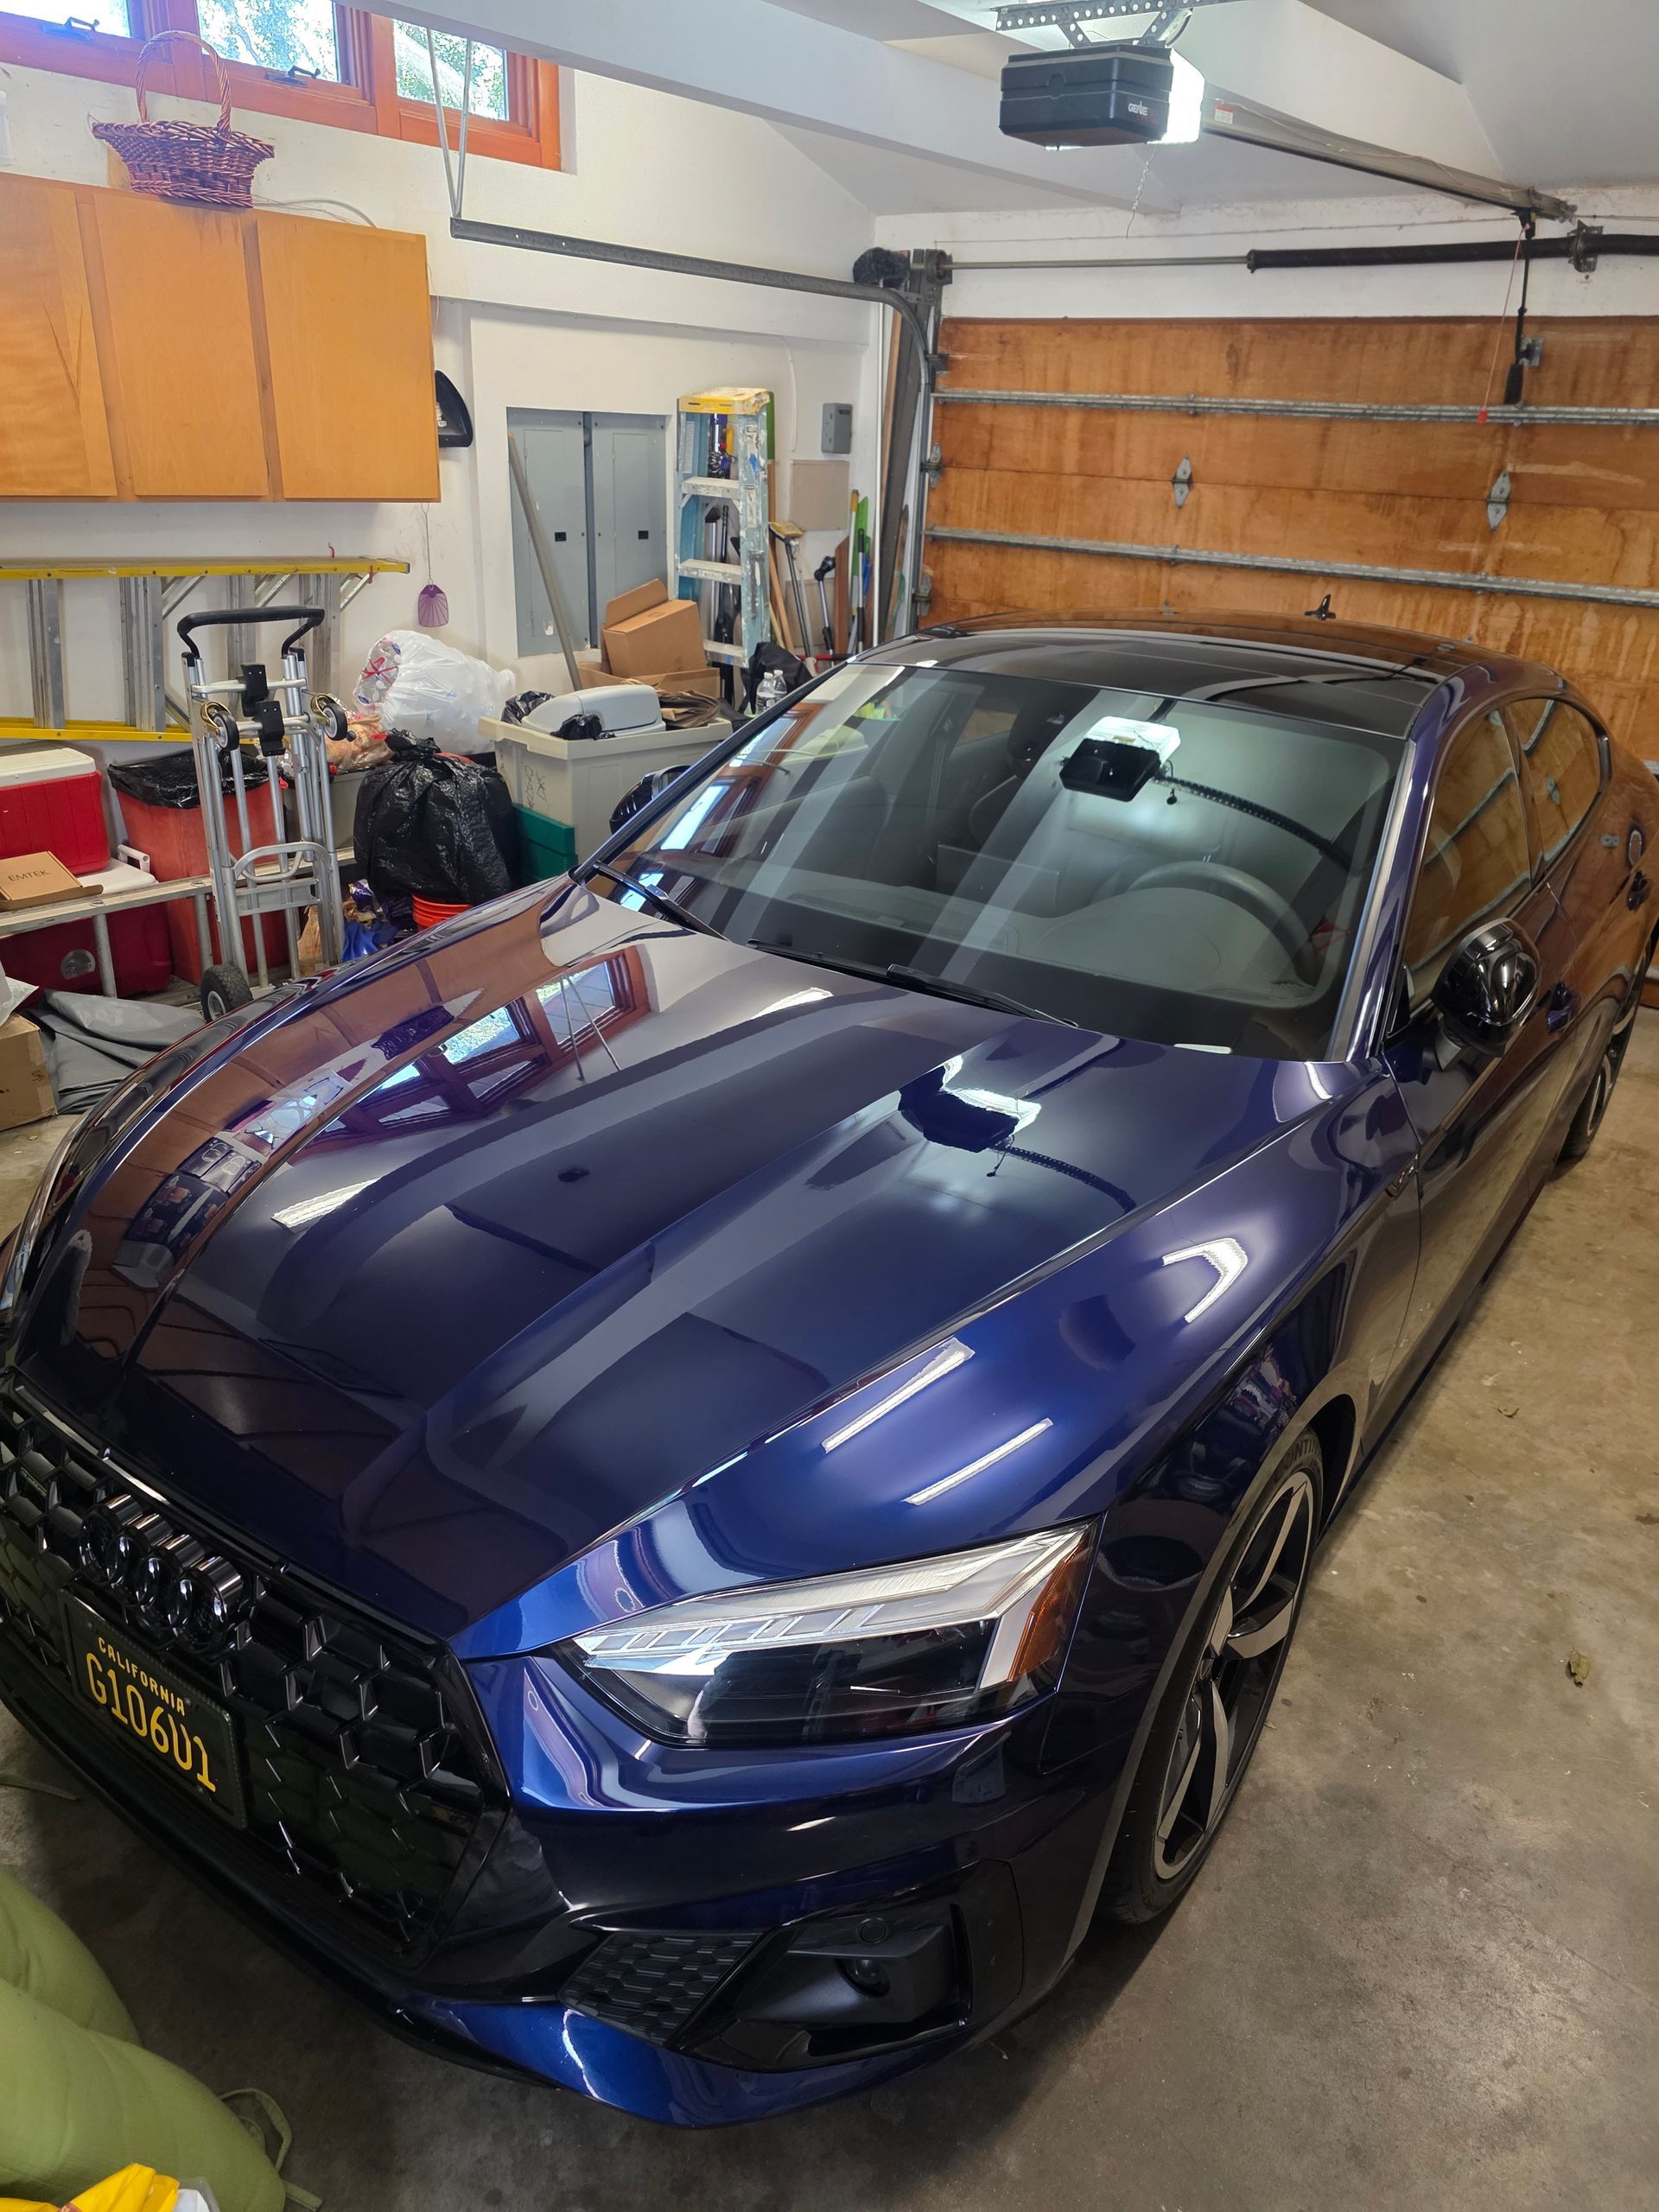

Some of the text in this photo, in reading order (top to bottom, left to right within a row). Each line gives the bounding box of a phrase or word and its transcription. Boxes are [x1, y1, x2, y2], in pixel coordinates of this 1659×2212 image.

[8, 869, 49, 882] EMTEK
[98, 1637, 186, 1716] CALIFORNIA
[86, 1652, 216, 1792] G106U1
